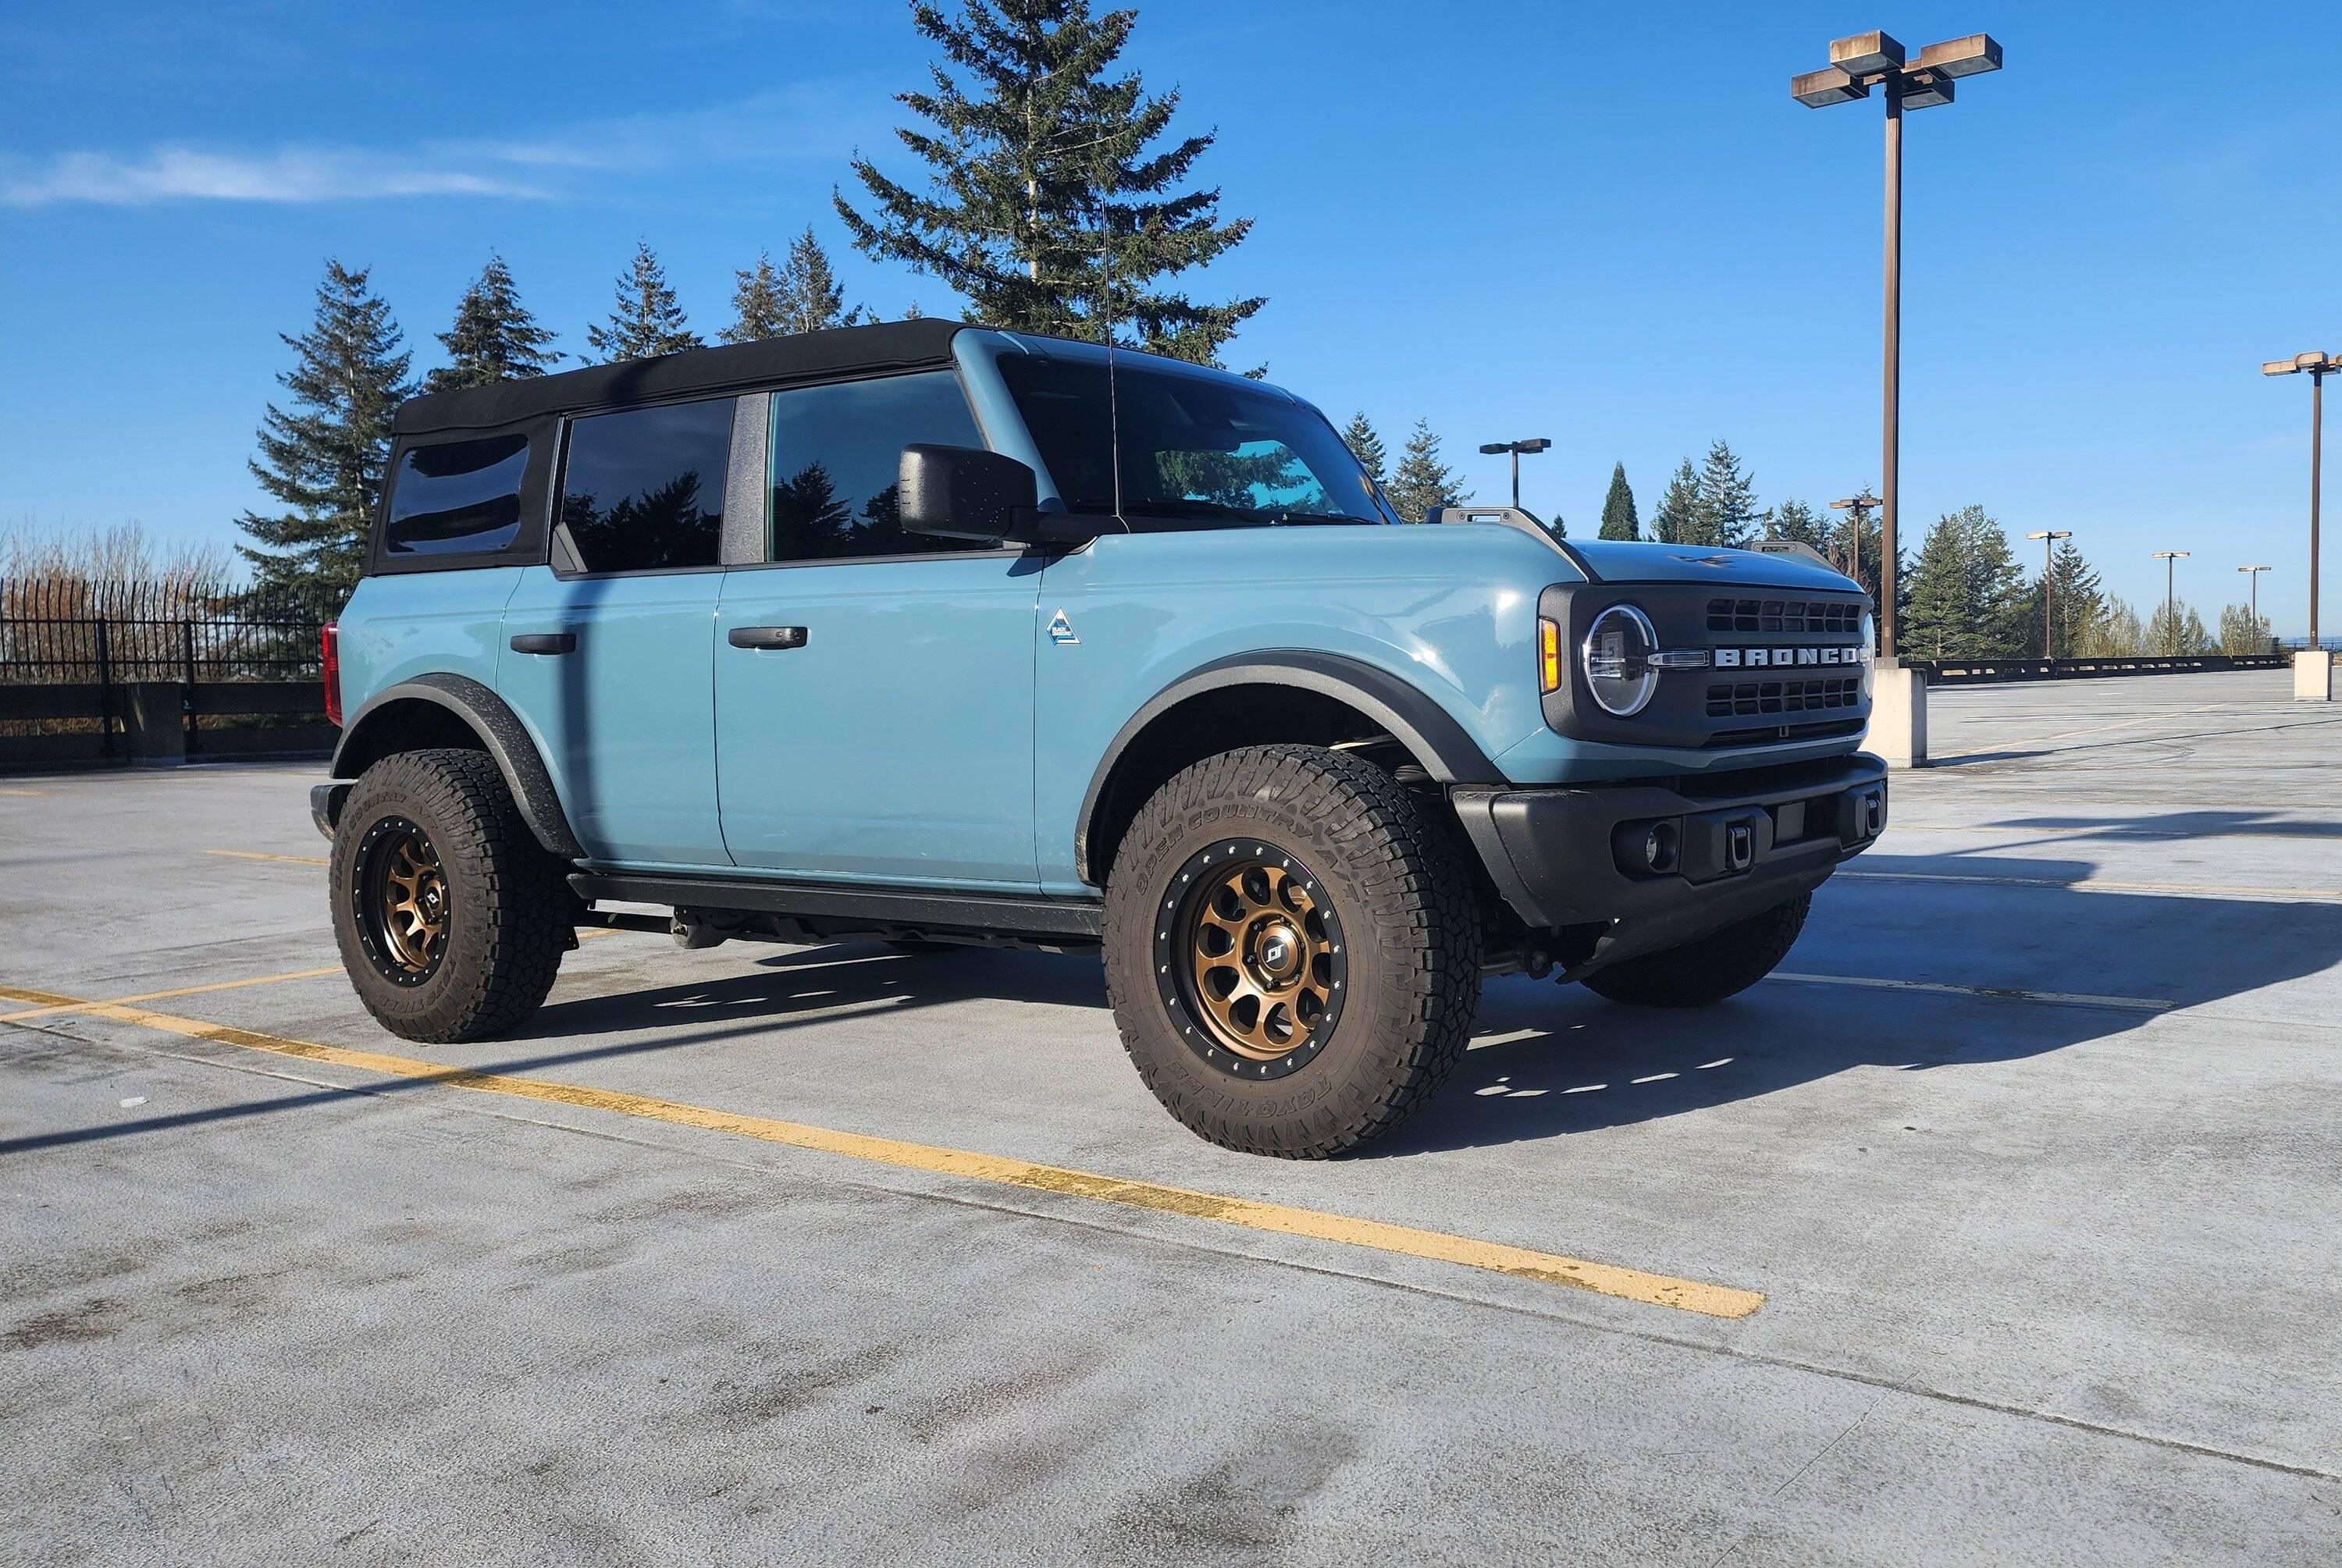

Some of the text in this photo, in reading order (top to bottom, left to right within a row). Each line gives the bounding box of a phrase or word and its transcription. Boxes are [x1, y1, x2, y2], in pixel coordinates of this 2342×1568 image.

[1715, 649, 1857, 667] BRONCO
[1136, 823, 1183, 896] OPEN
[1188, 803, 1312, 838] COUNTRY
[1171, 1062, 1332, 1118] TOYO TIRES
